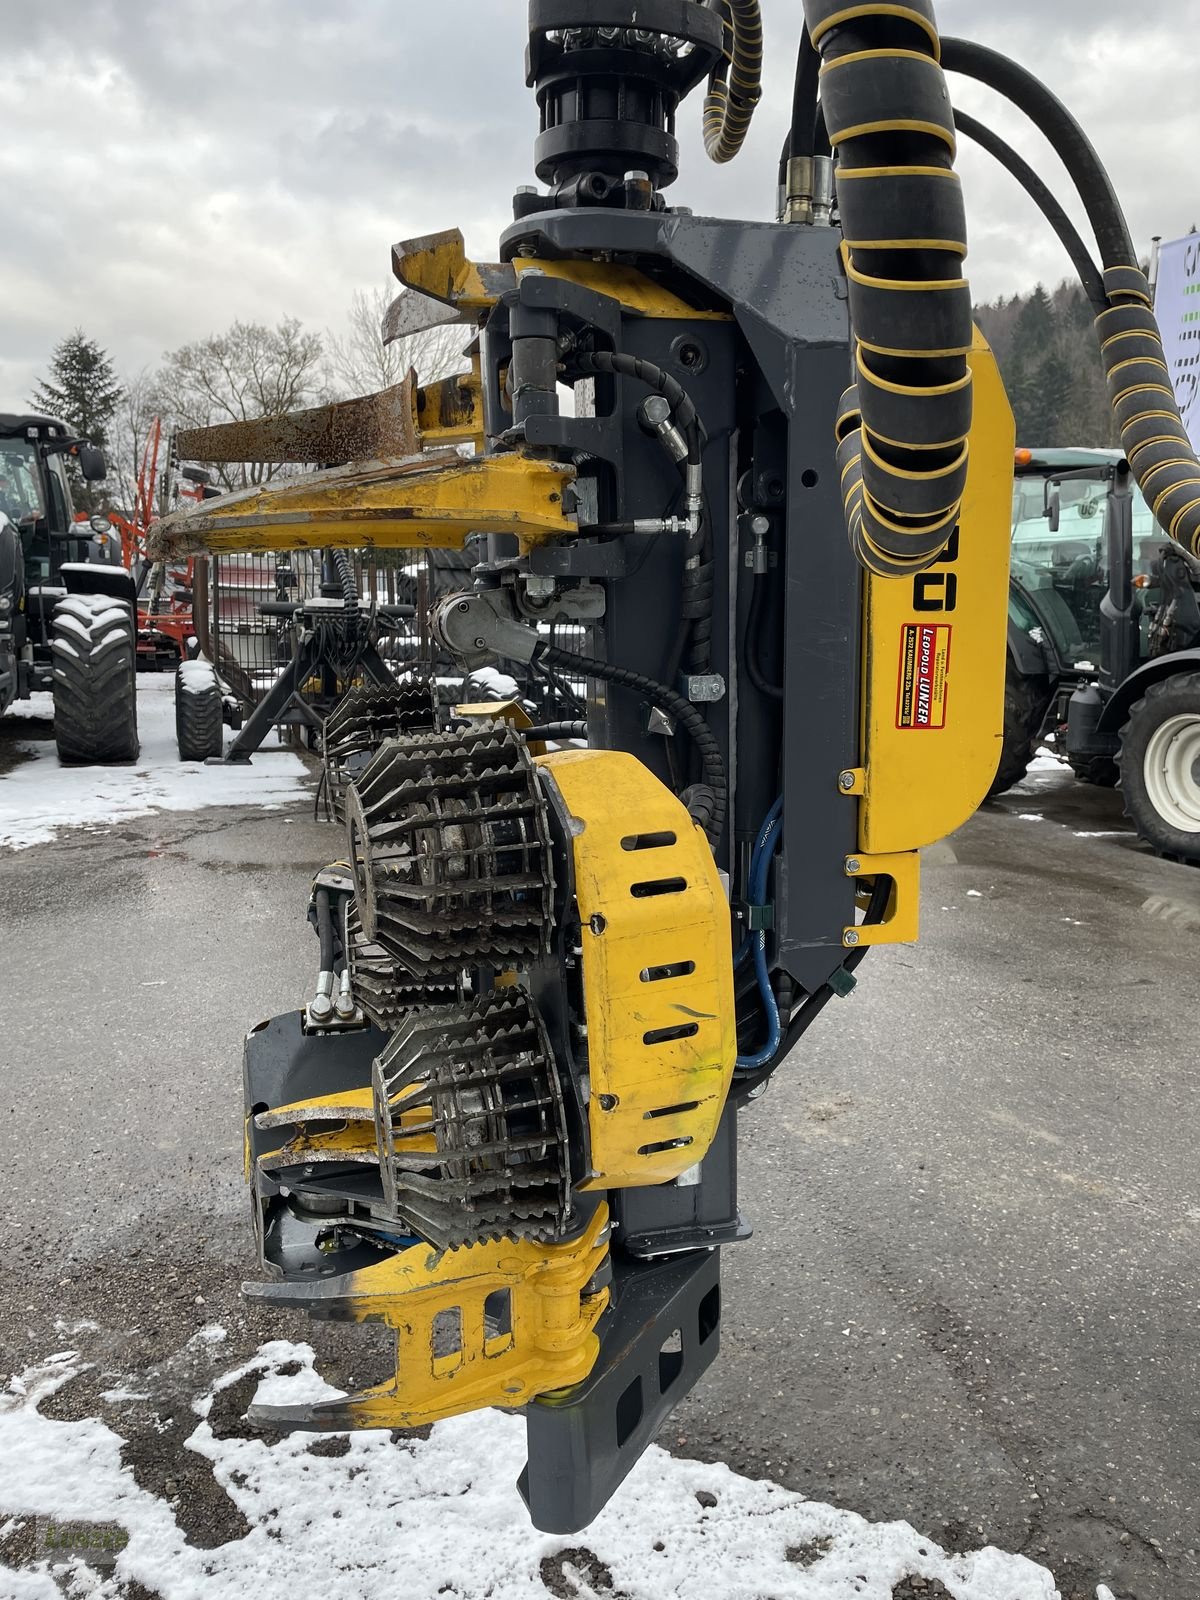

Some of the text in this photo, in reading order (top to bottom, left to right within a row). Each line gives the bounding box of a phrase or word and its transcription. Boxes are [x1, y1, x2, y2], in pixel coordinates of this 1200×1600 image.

[905, 649, 914, 680] KAUMBERG
[917, 628, 934, 724] LEOPOLD LUNZER
